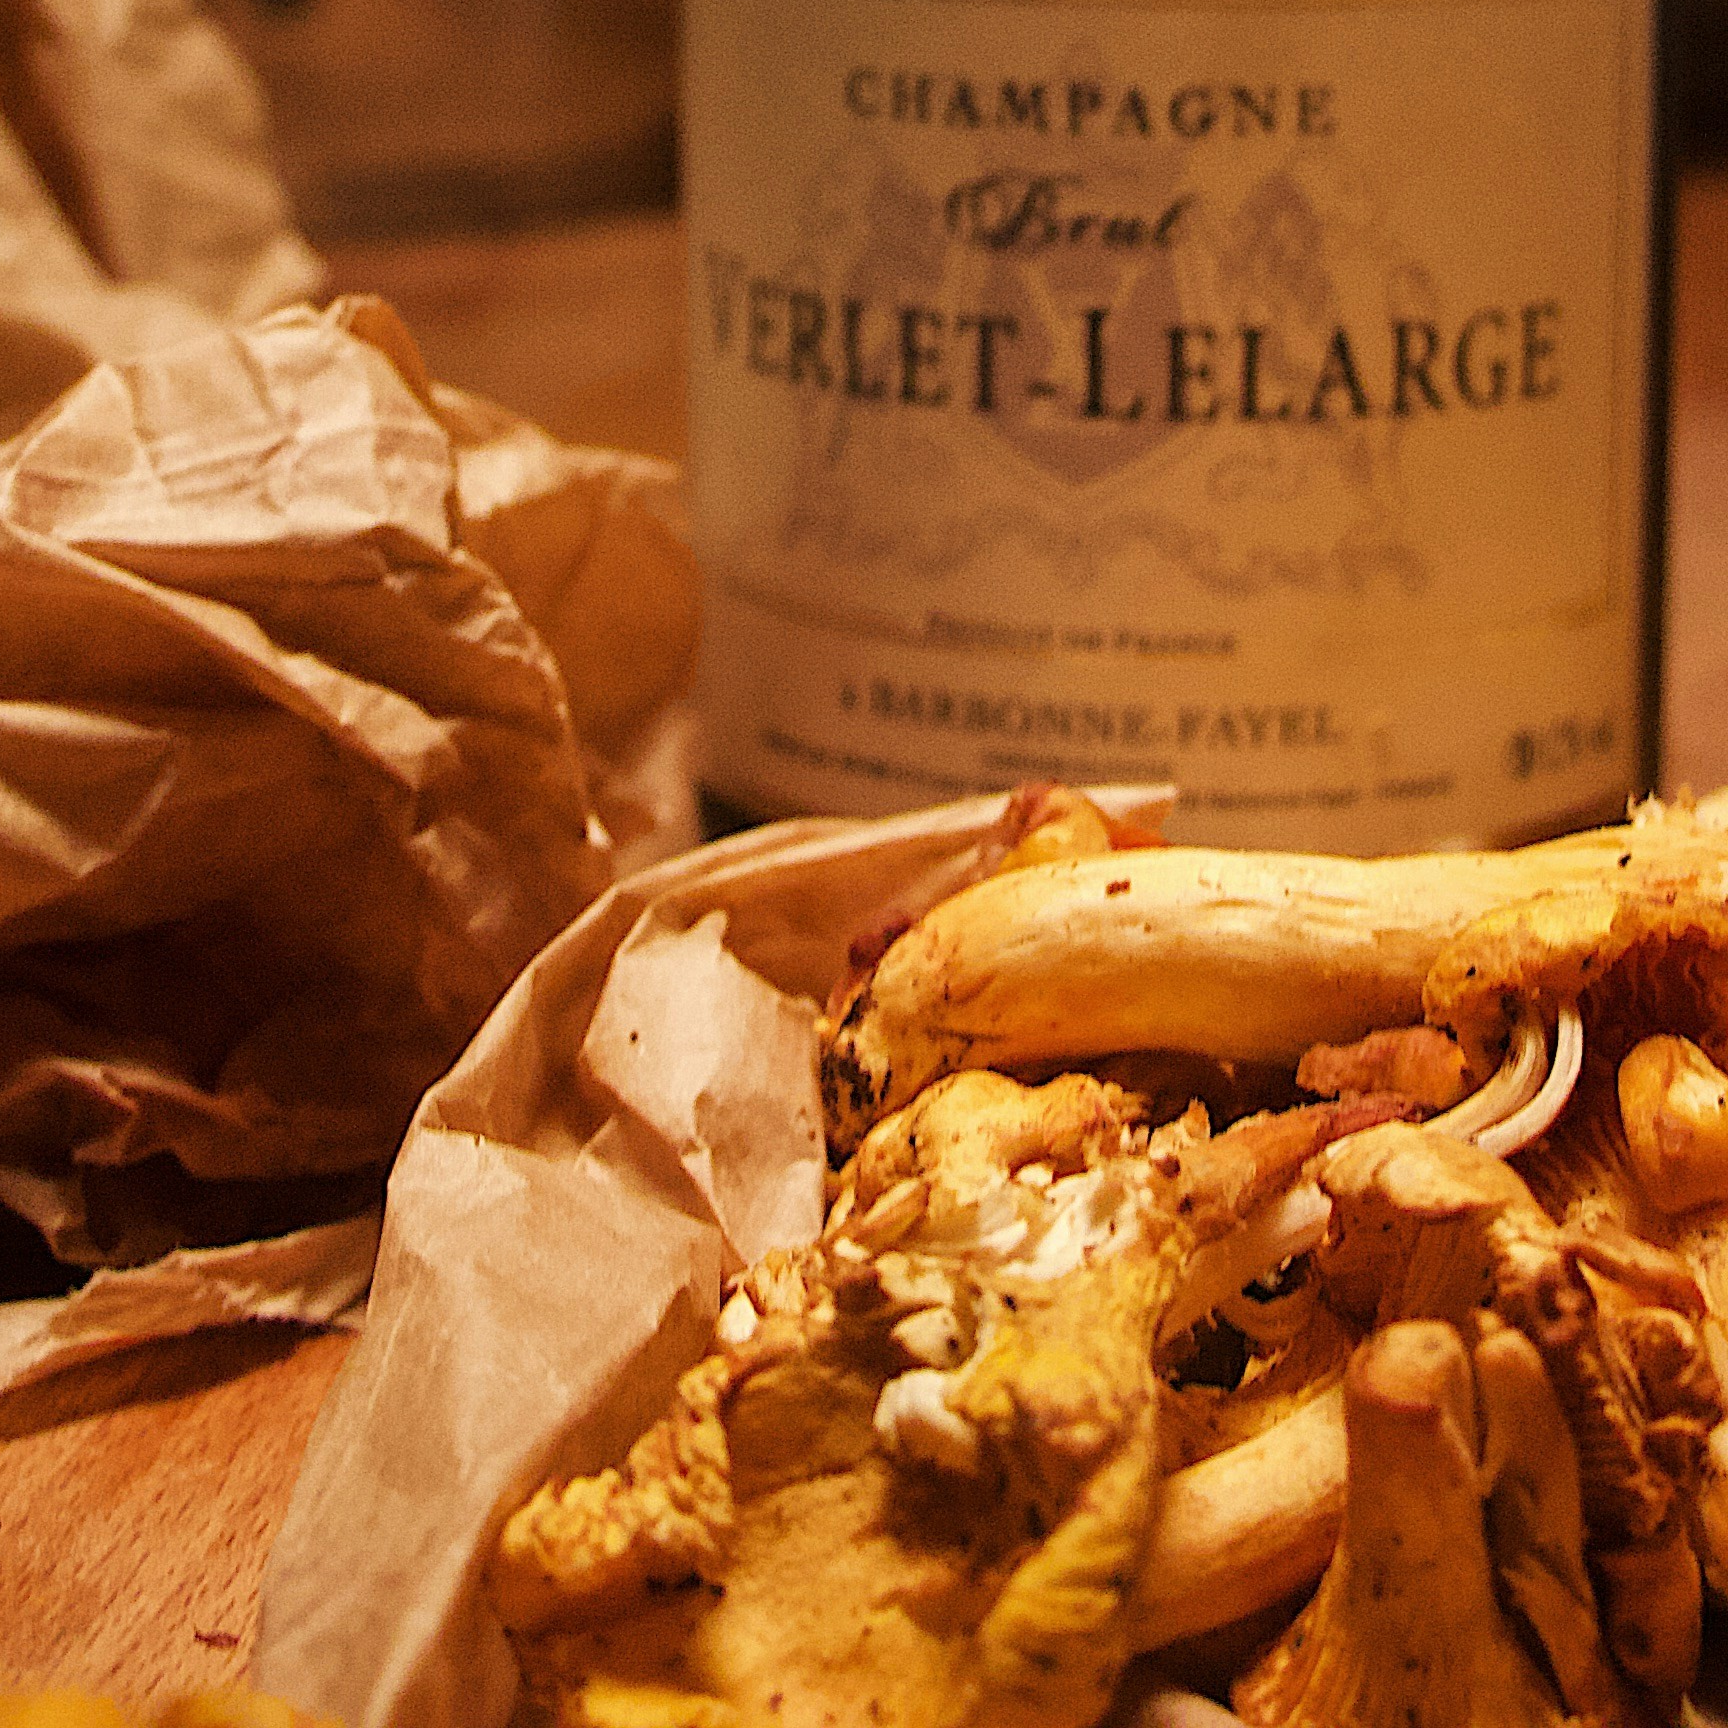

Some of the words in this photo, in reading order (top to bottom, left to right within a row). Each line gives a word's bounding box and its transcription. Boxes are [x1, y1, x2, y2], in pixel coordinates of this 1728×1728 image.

[843, 72, 1338, 140] CHAMPAGNE
[943, 170, 1195, 250] Brut
[704, 246, 1562, 424] VERLET-LELARGE
